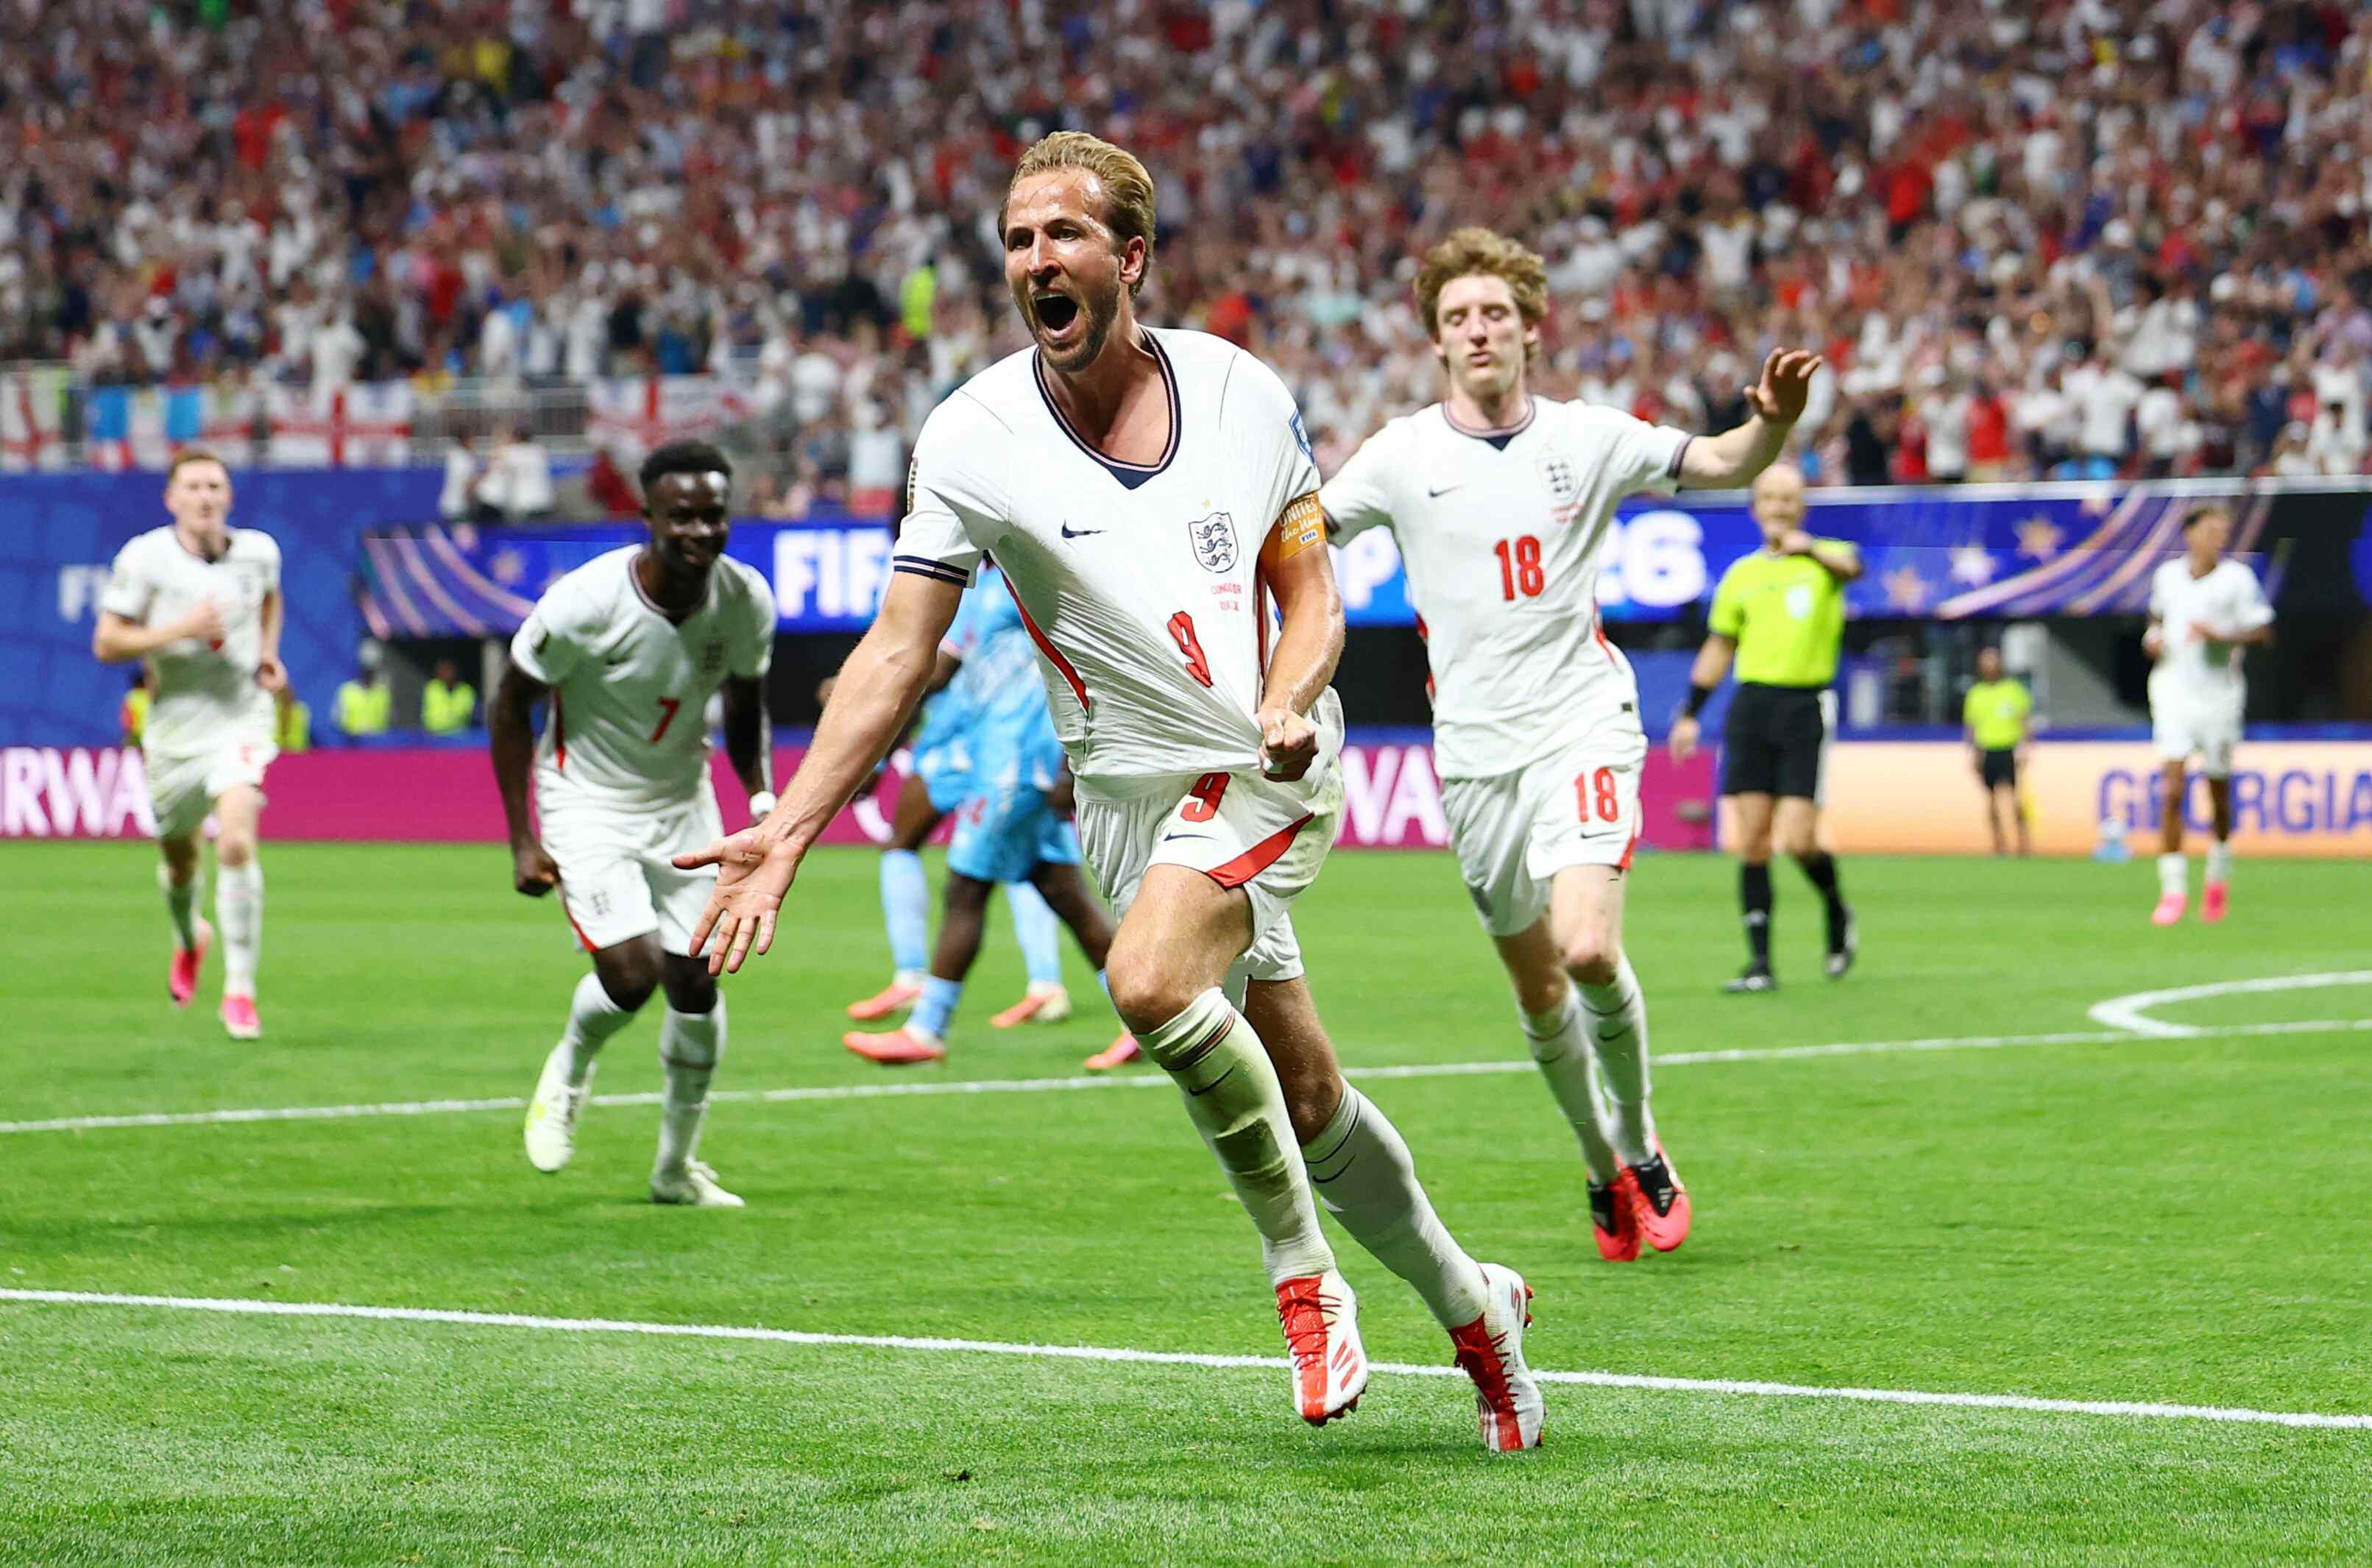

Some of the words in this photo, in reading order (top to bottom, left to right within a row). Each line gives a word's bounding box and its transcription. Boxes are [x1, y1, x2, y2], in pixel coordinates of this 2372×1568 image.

[1278, 498, 1318, 528] UNITES
[1300, 531, 1317, 542] FIFA
[774, 529, 893, 617] FIF
[1494, 535, 1545, 601] 18
[1166, 610, 1214, 688] 9
[649, 698, 680, 746] 7
[2, 745, 157, 837] RWA
[1180, 772, 1231, 823] 9
[1574, 767, 1618, 823] 18
